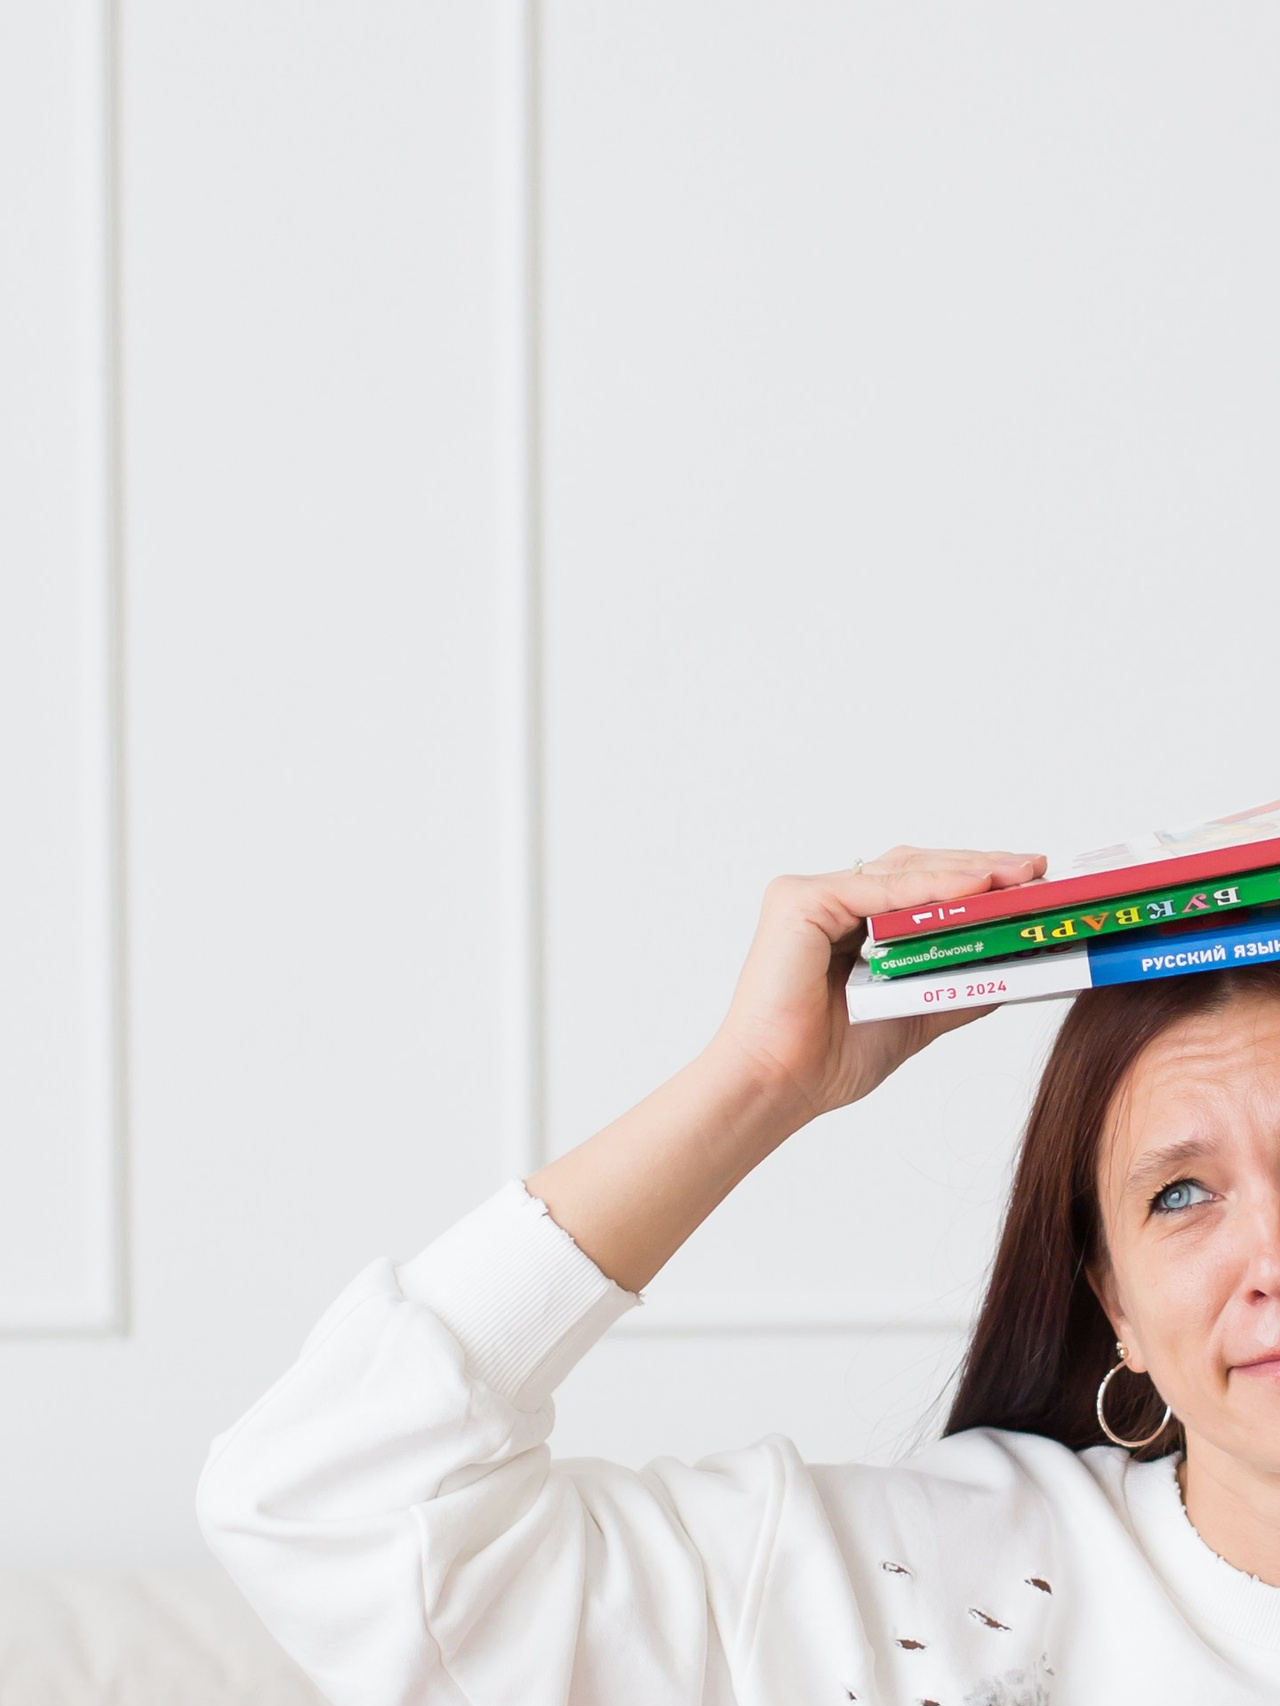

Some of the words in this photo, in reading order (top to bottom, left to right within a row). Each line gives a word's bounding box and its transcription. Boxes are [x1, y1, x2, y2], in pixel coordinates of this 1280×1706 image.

[1019, 885, 1242, 943] БУКВАРЬ
[1141, 942, 1227, 972] РУССКИЙ
[923, 987, 958, 1003] ОГЭ
[966, 980, 1008, 998] 2024
